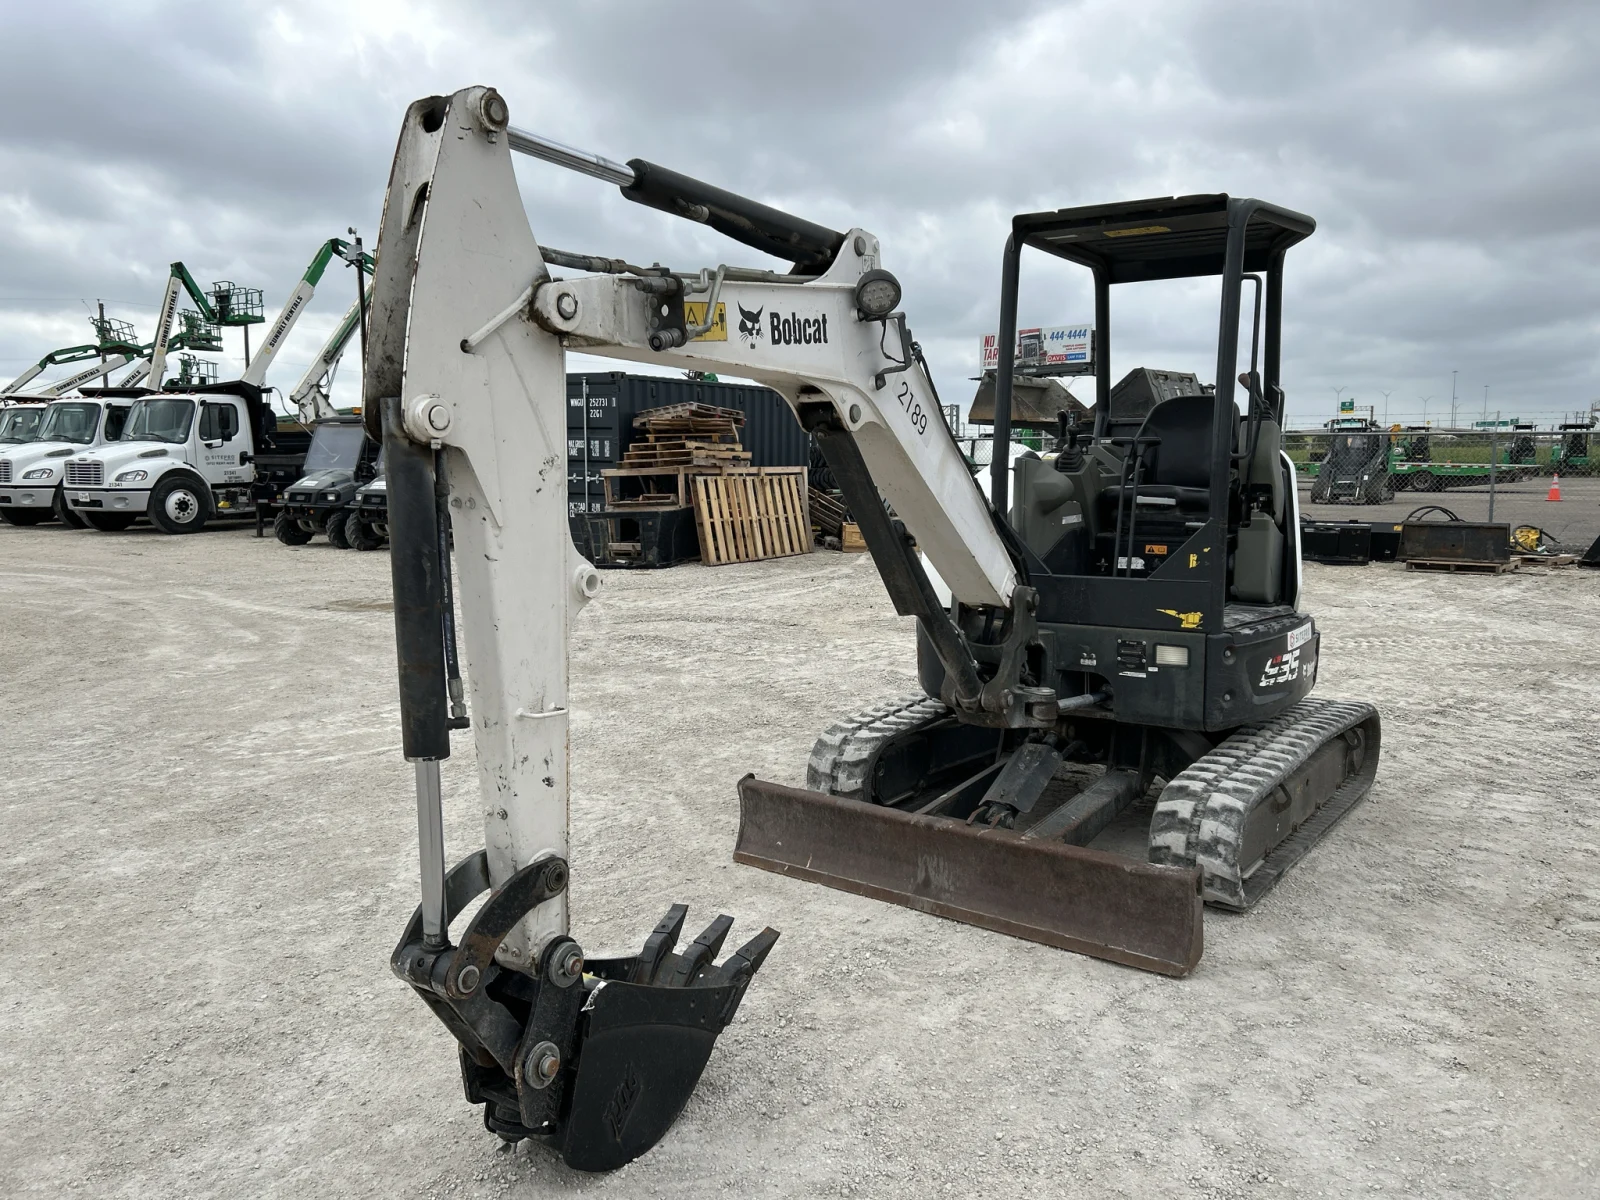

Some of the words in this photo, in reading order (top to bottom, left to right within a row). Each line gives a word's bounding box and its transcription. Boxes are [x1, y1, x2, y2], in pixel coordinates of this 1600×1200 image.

[160, 318, 171, 349] SUNBELT
[166, 290, 178, 319] RENTALS
[269, 321, 287, 348] SUNBELT
[286, 295, 303, 322] RENTALS
[770, 311, 828, 345] Bobcat
[984, 335, 996, 348] NO
[1050, 329, 1087, 341] 444-4444
[56, 379, 78, 392] SUNBELT
[77, 368, 101, 382] RENTALS
[589, 397, 608, 407] 252731
[897, 381, 929, 436] 2189
